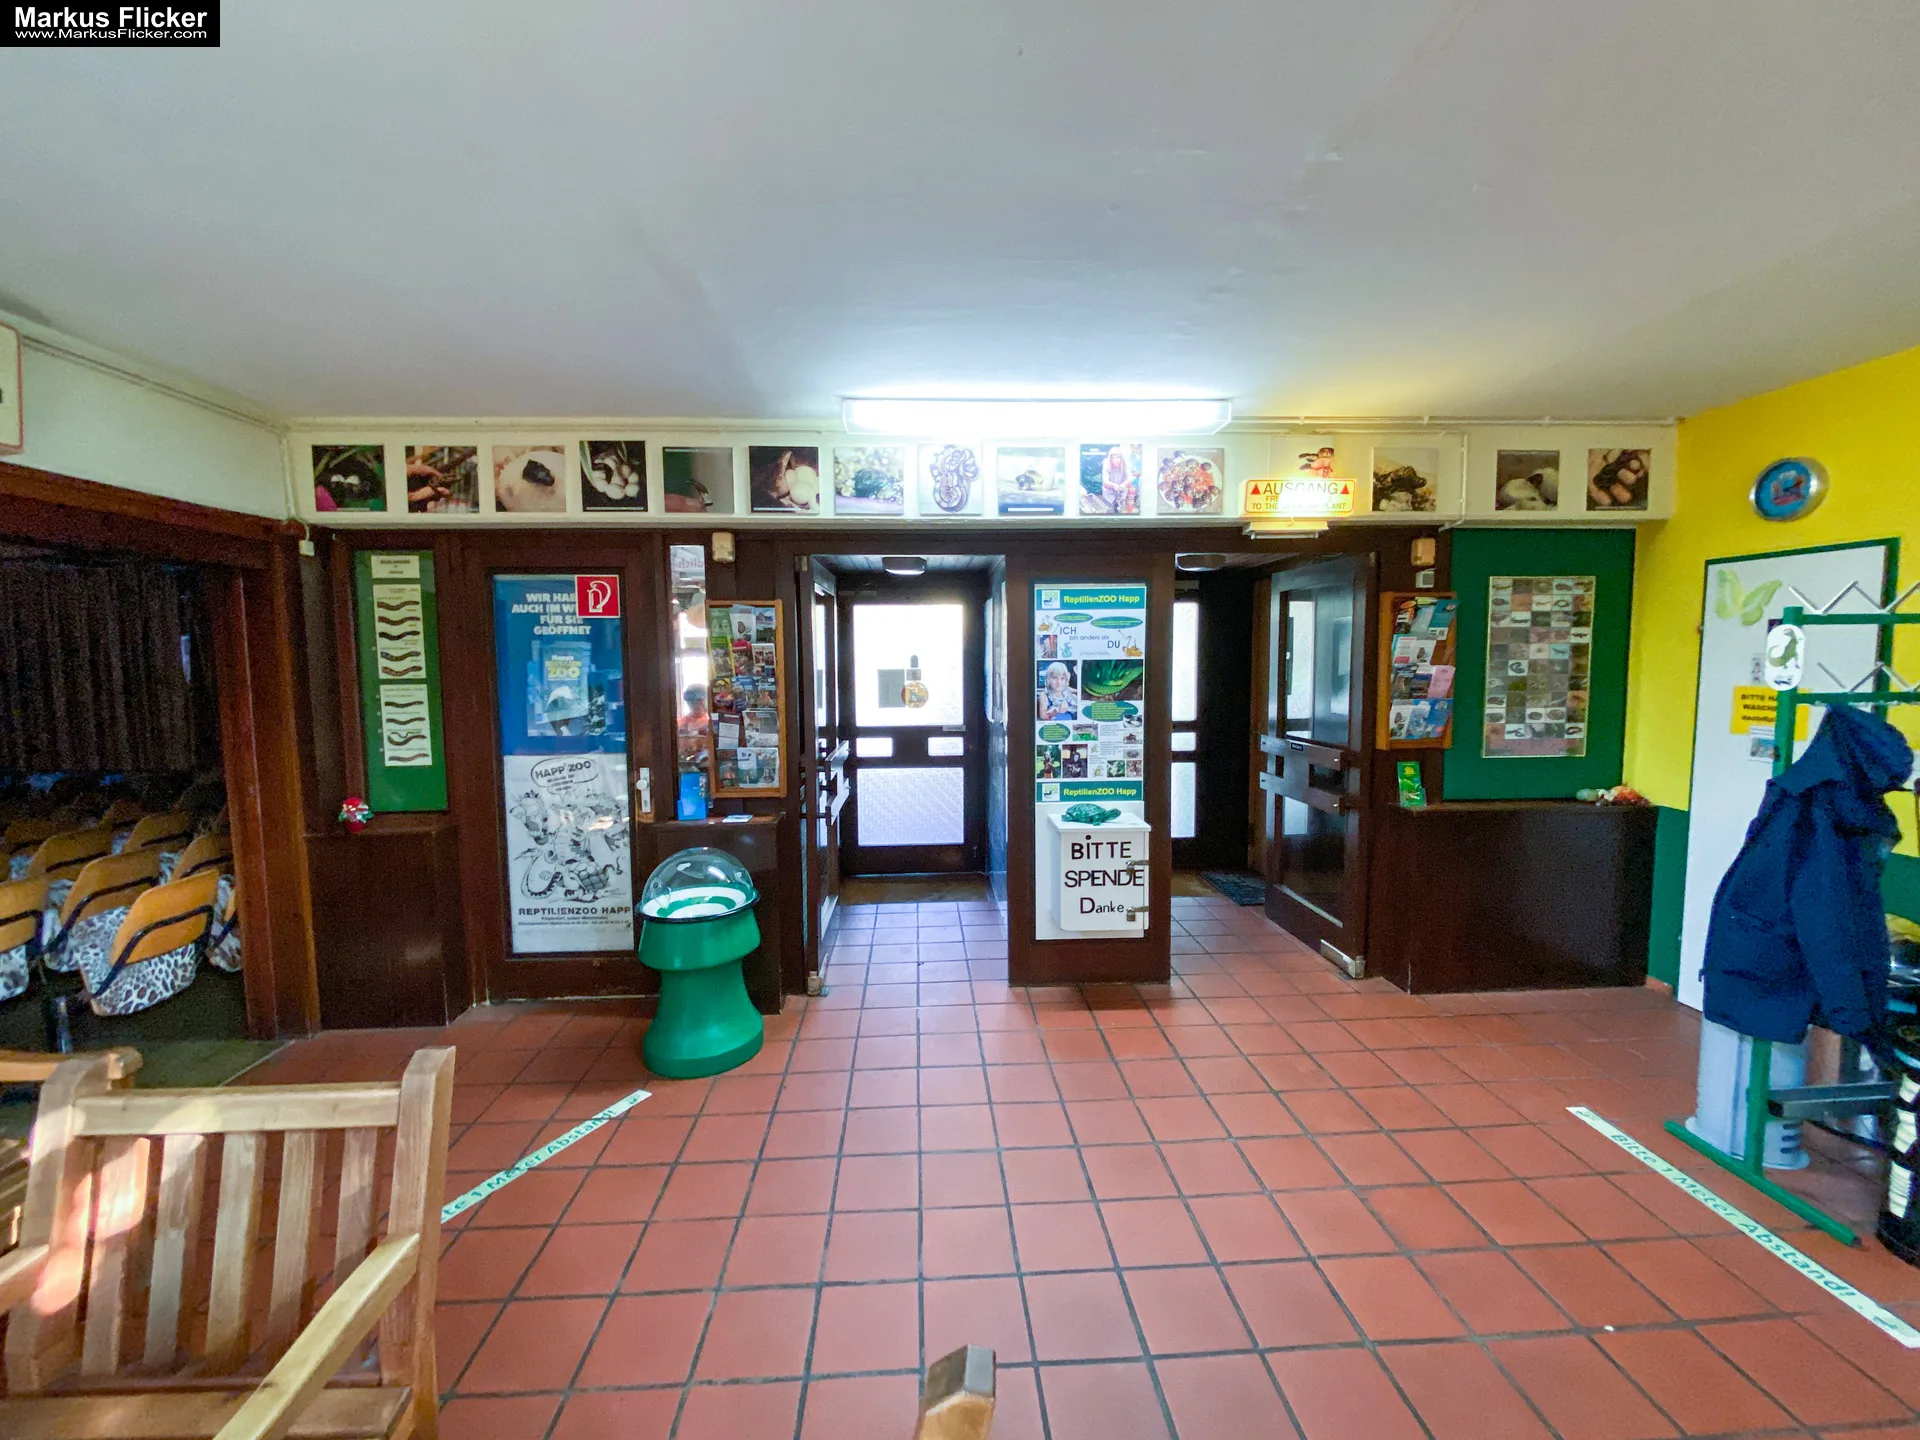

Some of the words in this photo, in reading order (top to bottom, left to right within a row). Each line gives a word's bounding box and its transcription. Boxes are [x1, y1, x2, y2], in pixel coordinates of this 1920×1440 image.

[1263, 482, 1339, 495] AUSGANG
[1252, 502, 1262, 510] TO
[1265, 502, 1278, 510] THE
[525, 592, 551, 602] WIR
[1063, 595, 1117, 605] ReptilienZOO
[1118, 595, 1140, 604] Happ
[511, 603, 544, 613] AUCH
[545, 603, 561, 613] IM
[1060, 626, 1077, 635] ICH
[1107, 640, 1121, 649] DU
[568, 760, 592, 773] ZOO
[1063, 787, 1115, 797] ReptilienZOO
[1116, 787, 1137, 796] Happ
[1064, 869, 1145, 888] SPENDE
[518, 907, 598, 915] REPTILIENZOO
[601, 906, 631, 914] HAPP
[1080, 897, 1125, 914] Danke
[486, 1154, 542, 1190] Meter
[1610, 1134, 1657, 1163] Bitte
[1672, 1177, 1739, 1218] Meter
[1739, 1222, 1857, 1297] Abstand!
